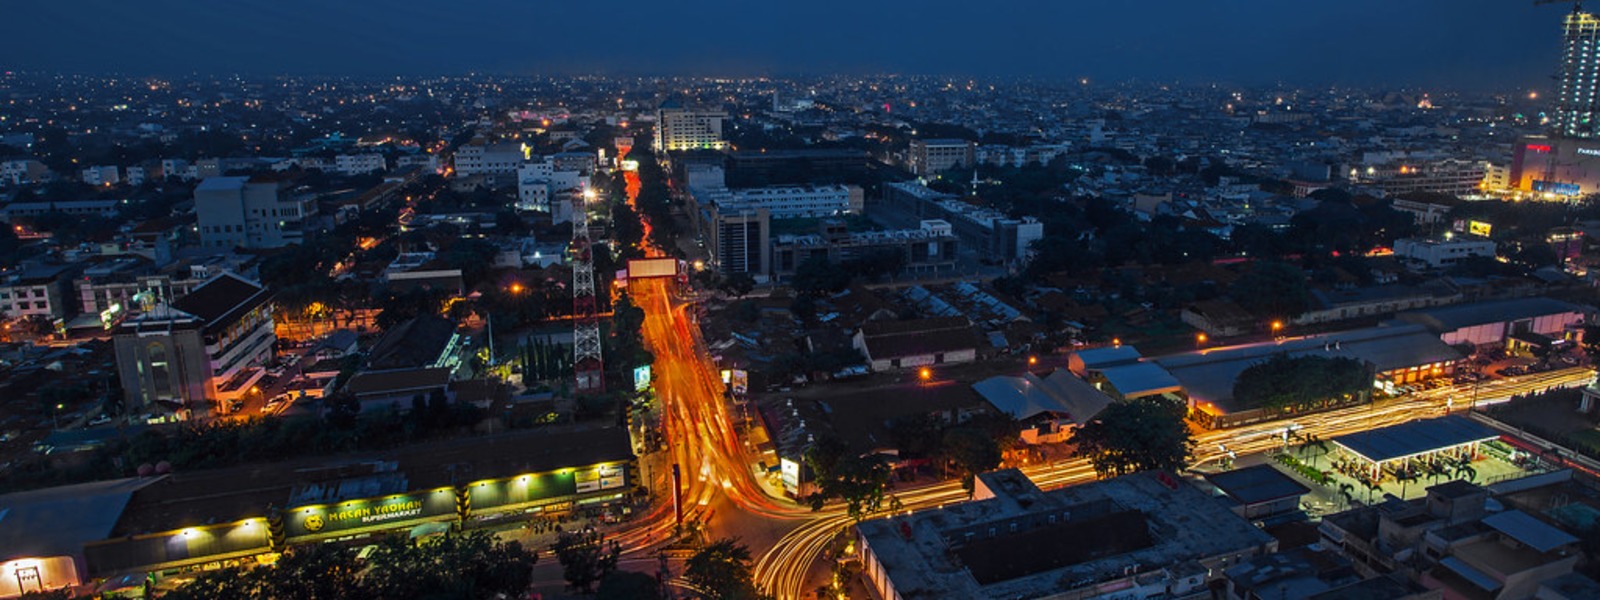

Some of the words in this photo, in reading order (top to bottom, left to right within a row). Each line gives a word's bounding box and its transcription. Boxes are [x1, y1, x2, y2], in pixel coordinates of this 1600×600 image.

[329, 507, 370, 521] MACAN
[374, 500, 422, 514] YAOHAN
[361, 507, 422, 522] SUPERMARKET
